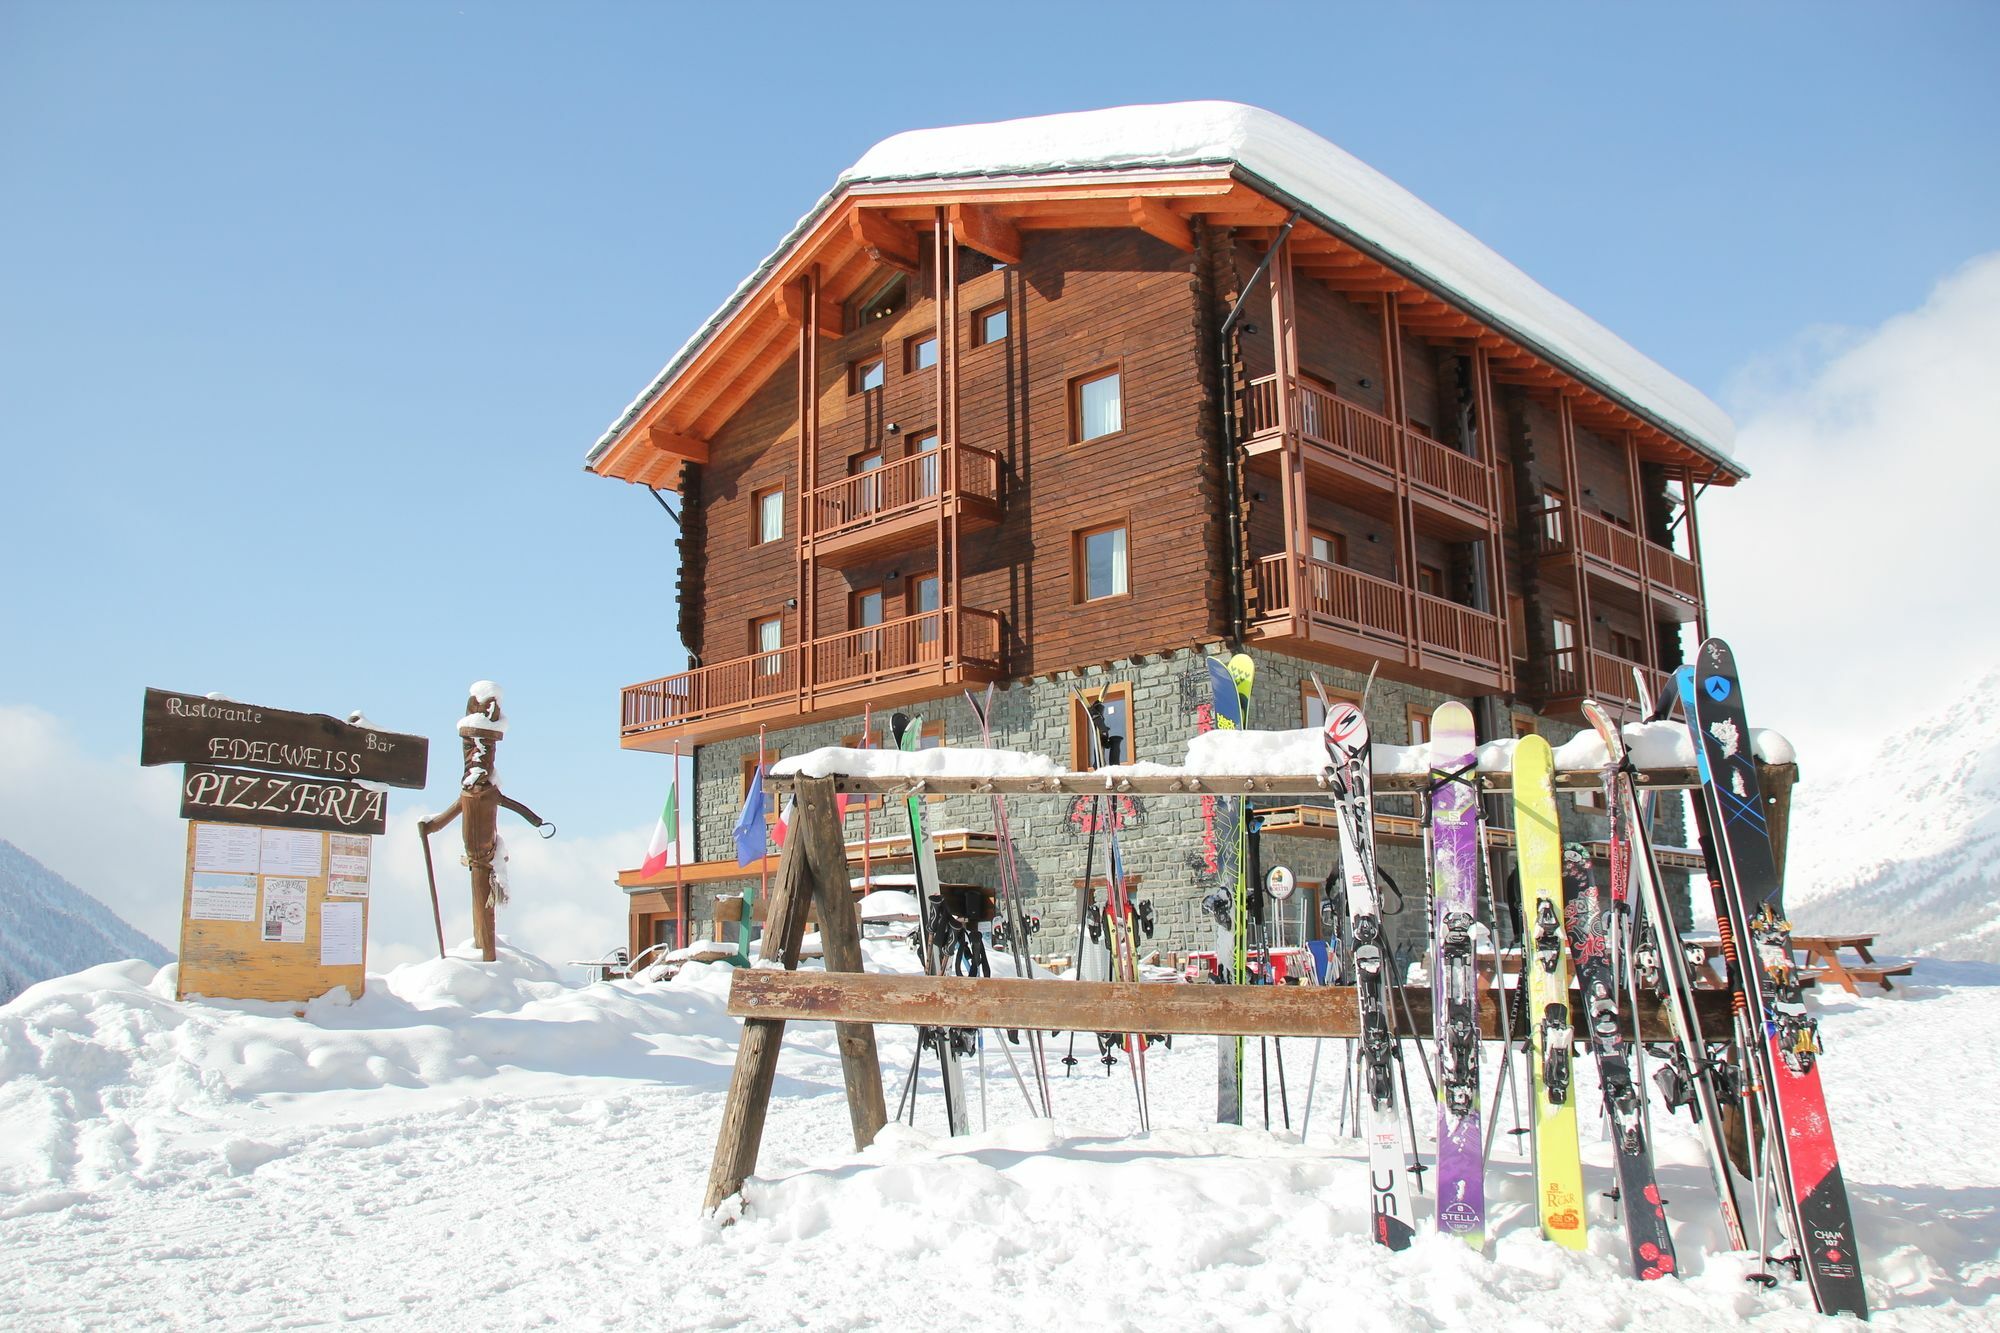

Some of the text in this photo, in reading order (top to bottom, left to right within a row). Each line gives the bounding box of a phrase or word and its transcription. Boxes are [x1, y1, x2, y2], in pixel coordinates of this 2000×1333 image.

[166, 697, 262, 724] Ristorante
[208, 737, 361, 775] EDELWEISS
[186, 772, 384, 826] PIZZERIA
[1441, 1213, 1480, 1222] STELLA
[1814, 1230, 1845, 1241] CHAM
